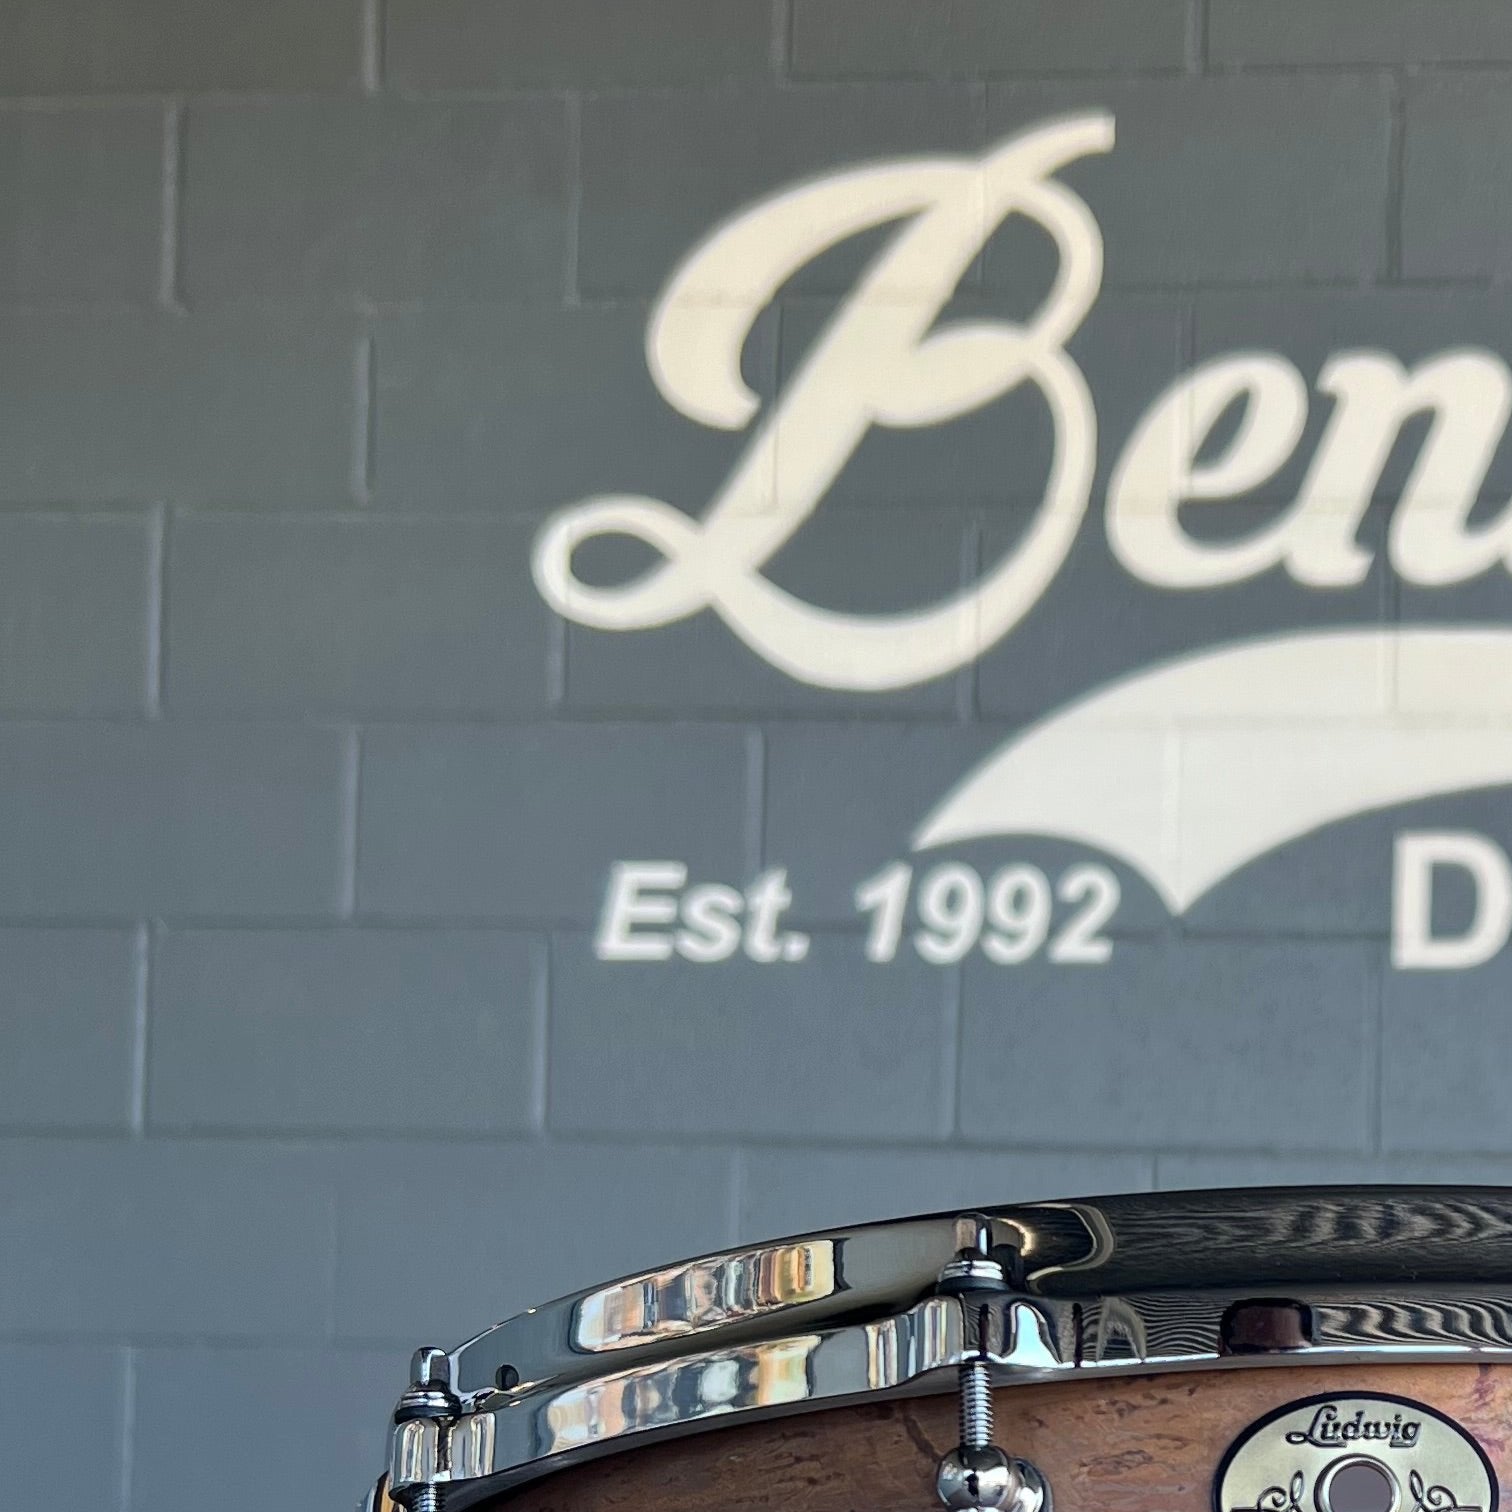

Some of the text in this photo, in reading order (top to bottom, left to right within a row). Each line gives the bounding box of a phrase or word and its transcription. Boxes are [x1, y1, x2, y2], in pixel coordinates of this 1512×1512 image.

[596, 862, 1120, 964] Est. 1992
[1285, 1404, 1421, 1448] Ludwig
